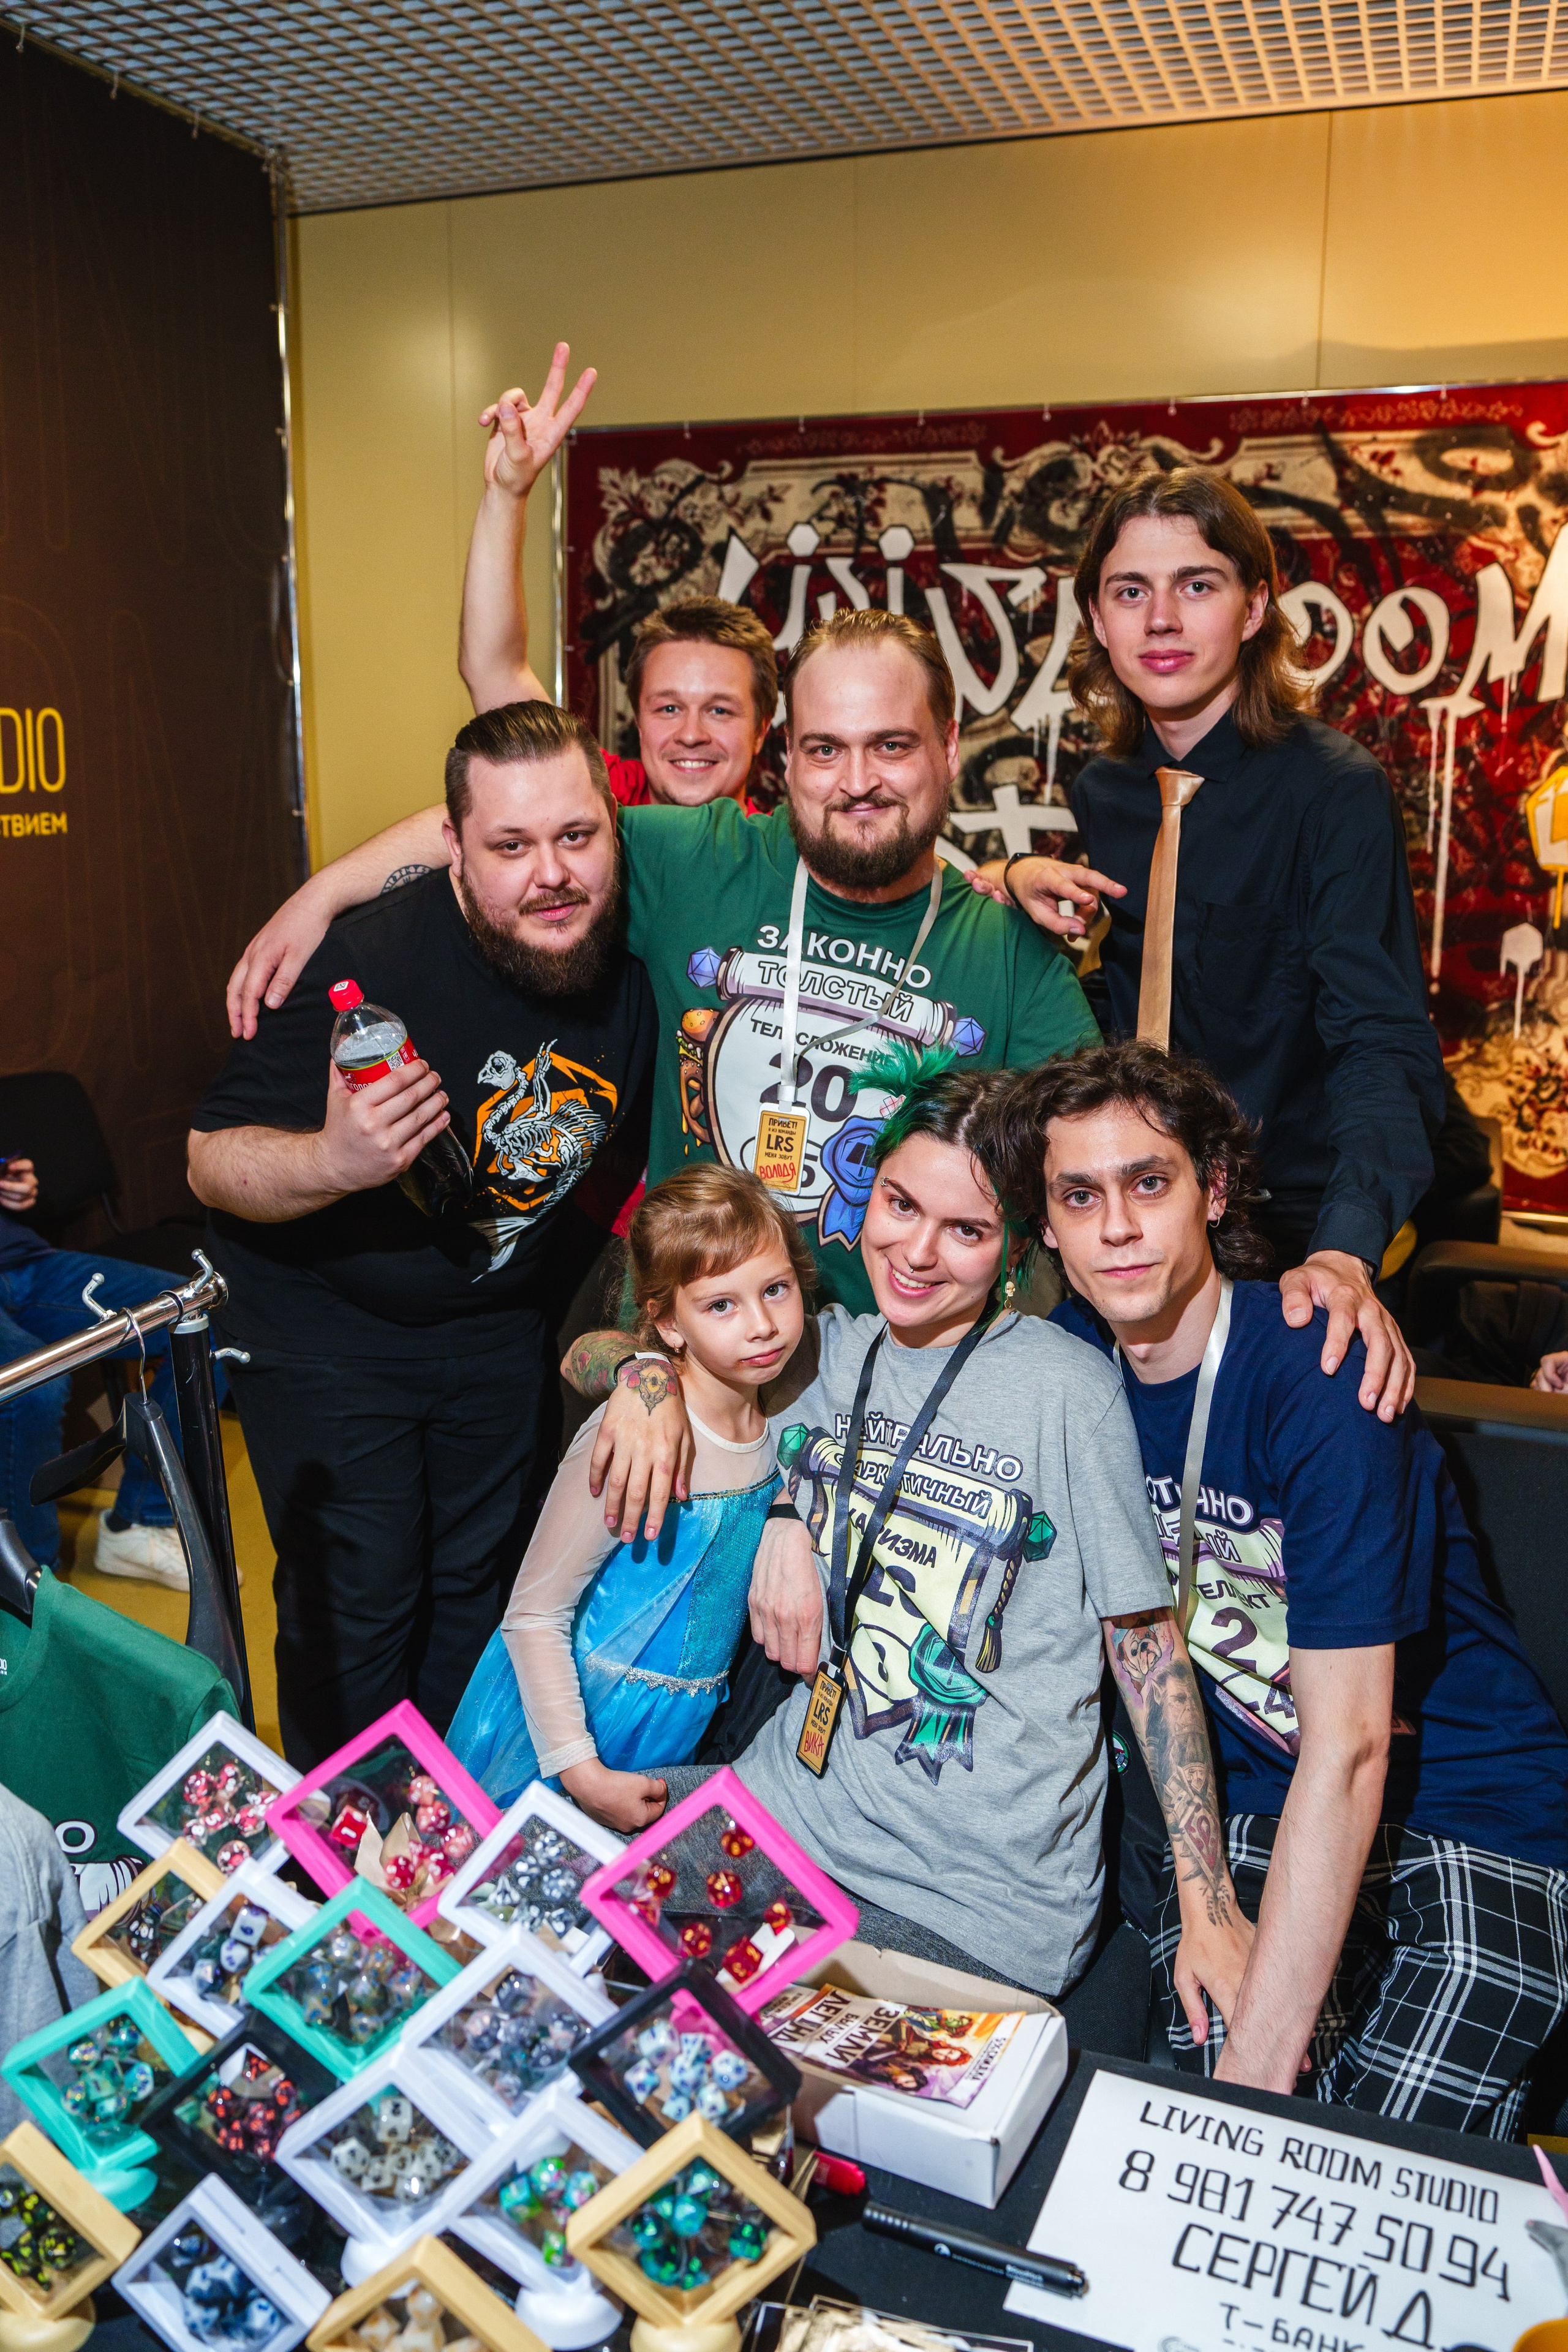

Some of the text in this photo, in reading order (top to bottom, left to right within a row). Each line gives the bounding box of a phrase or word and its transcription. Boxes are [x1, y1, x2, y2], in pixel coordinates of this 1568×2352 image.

[0, 707, 66, 794] DIO
[768, 1117, 798, 1129] ПРИВЕТ!
[766, 1134, 794, 1153] LRS
[759, 1162, 796, 1183] ВОЛОДЯ
[1210, 1606, 1257, 1674] 2
[820, 1680, 837, 1700] ПРИВЕТ!
[813, 1698, 831, 1725] LRS
[818, 1724, 826, 1735] ЗОВУТ
[804, 1730, 824, 1757] ВИКА
[1139, 2100, 1499, 2224] LIVING ROOM STUDIO
[1118, 2149, 1156, 2193] 8
[1167, 2162, 1254, 2222] 981
[1271, 2185, 1357, 2246] 747
[1172, 2223, 1434, 2350] СЕРГЕЙ Д
